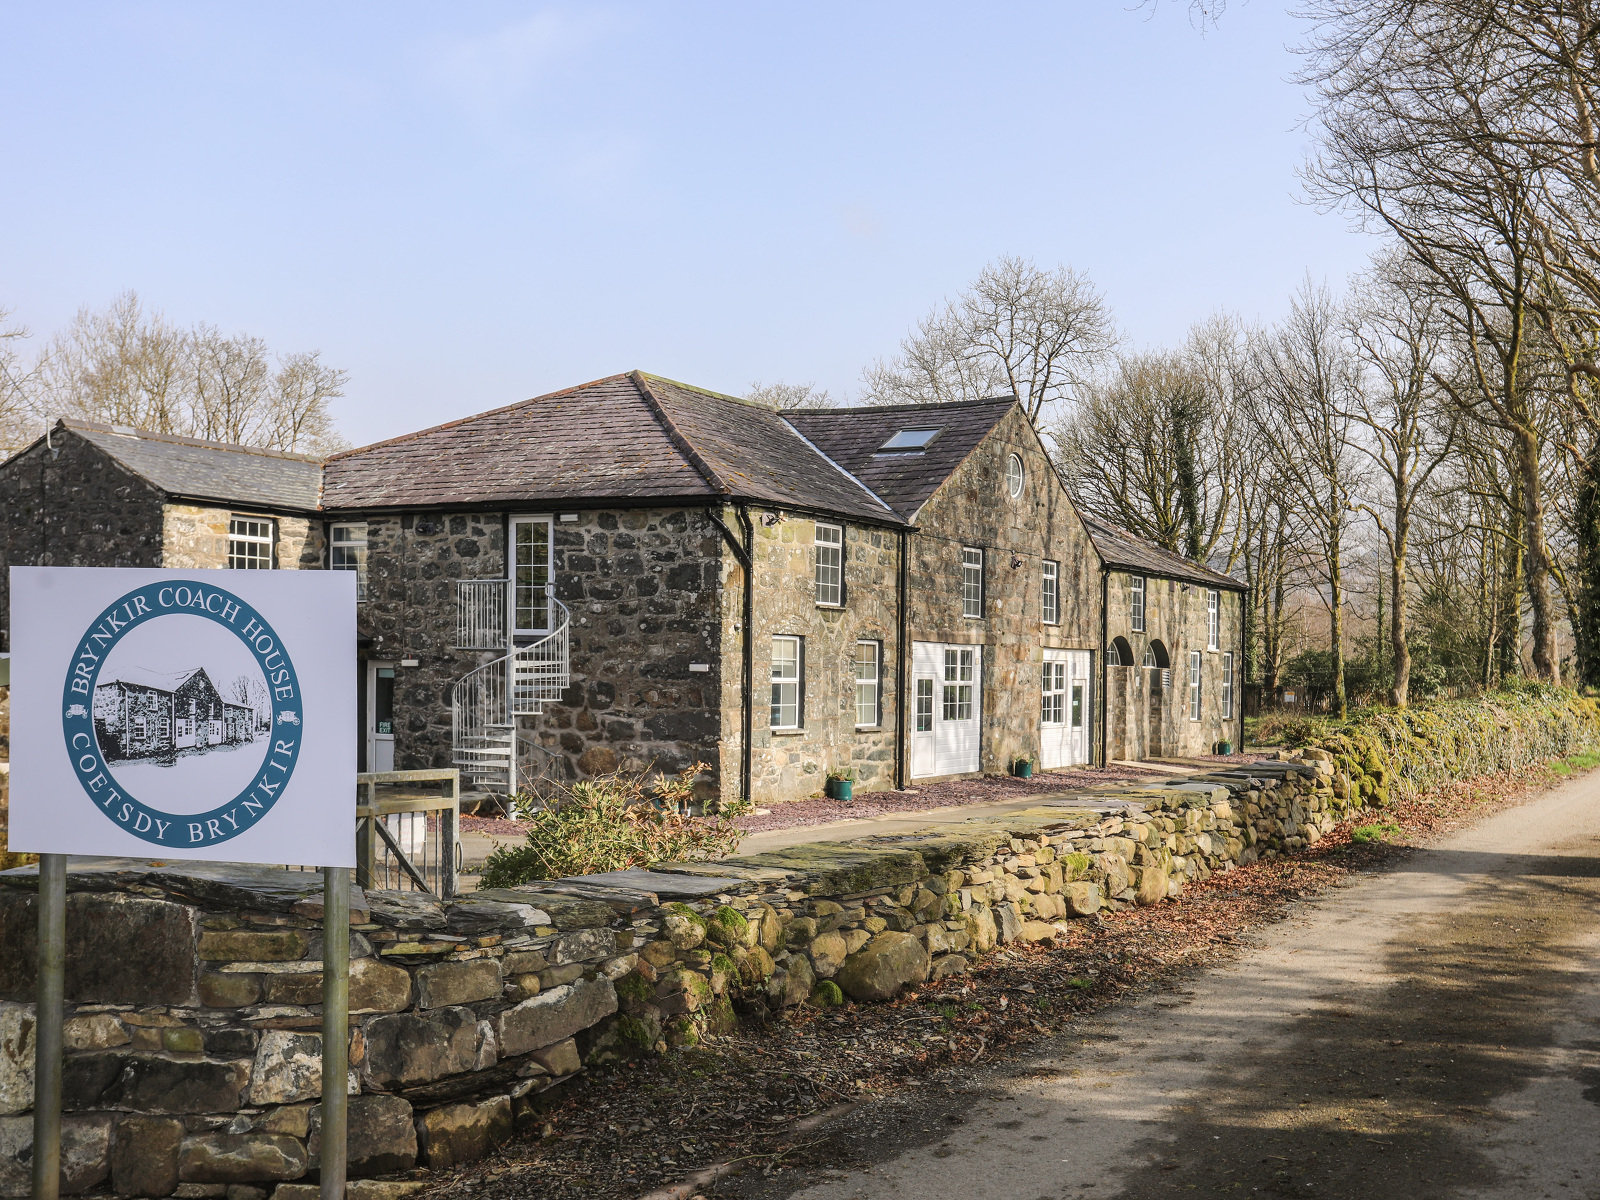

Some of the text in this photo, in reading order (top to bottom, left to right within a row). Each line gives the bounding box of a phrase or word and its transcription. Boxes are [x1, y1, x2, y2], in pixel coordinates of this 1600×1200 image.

[71, 586, 293, 701] BRYNKIR COACH HOUSE
[72, 732, 295, 843] COETSDY BRYNKIR
